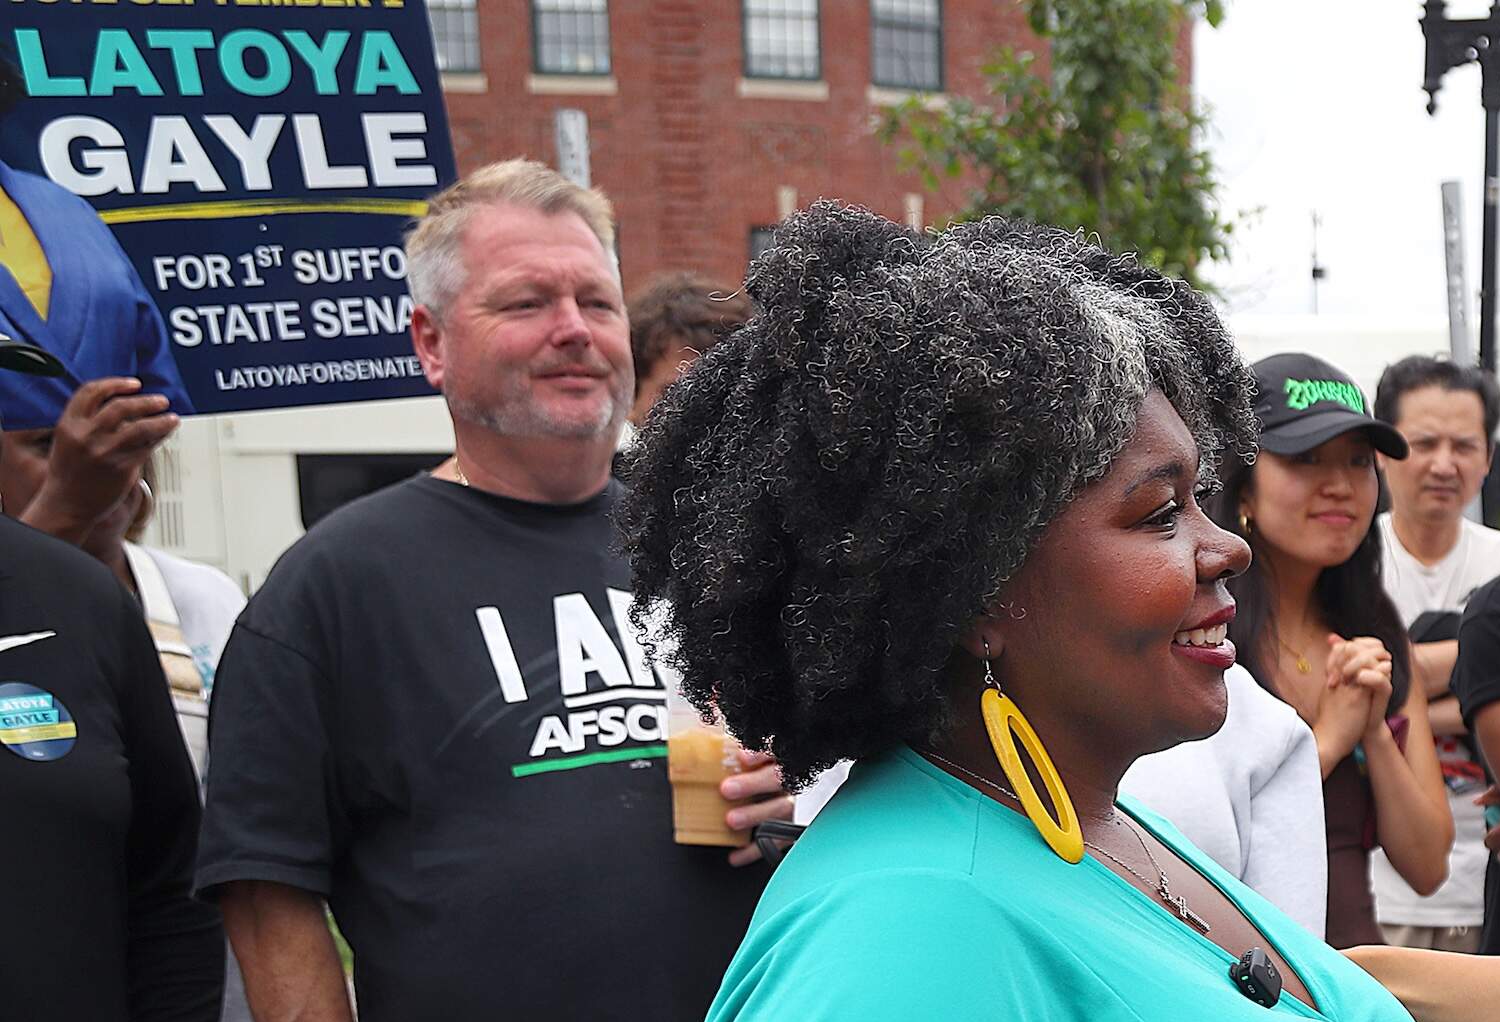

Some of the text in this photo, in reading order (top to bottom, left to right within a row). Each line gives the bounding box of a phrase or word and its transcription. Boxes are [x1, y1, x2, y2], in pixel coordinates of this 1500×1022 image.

[14, 27, 423, 97] LATOYA
[38, 112, 438, 196] GAYLE
[153, 253, 235, 291] FOR
[292, 245, 408, 285] SUFFO
[169, 294, 415, 348] STATE SENA
[475, 605, 529, 704] I
[2, 712, 53, 727] GAYLE
